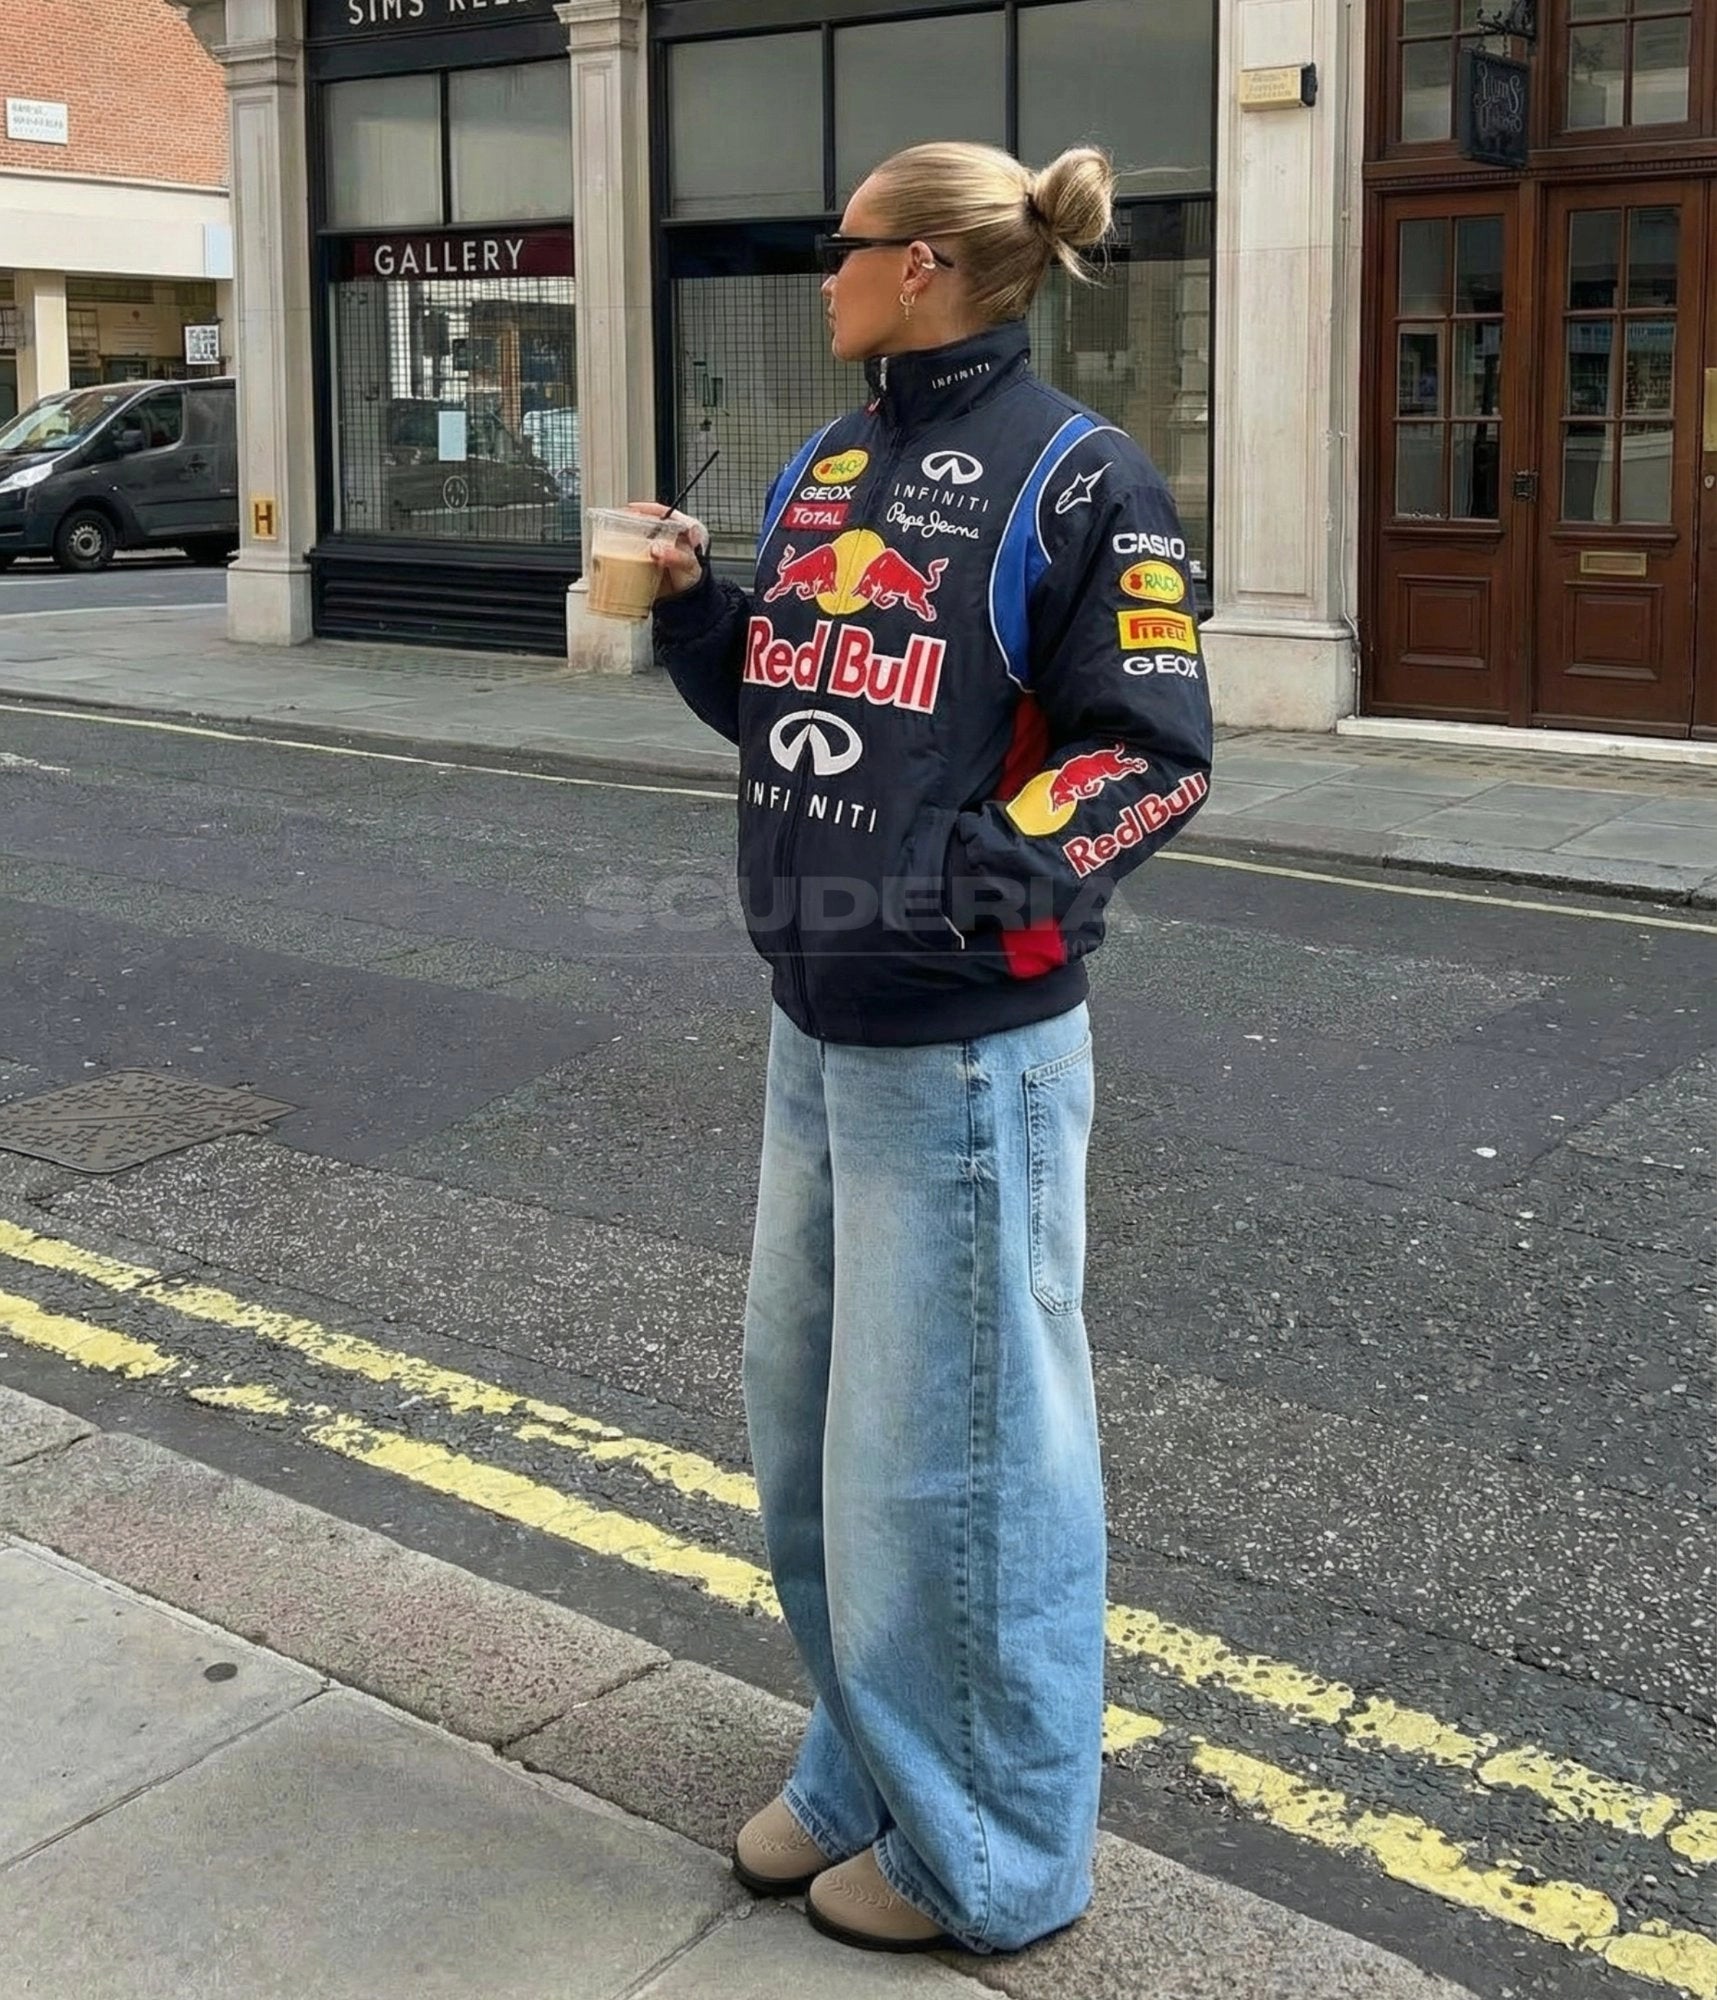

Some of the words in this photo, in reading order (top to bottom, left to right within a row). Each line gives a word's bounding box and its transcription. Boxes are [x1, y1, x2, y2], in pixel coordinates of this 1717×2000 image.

[374, 239, 524, 275] GALLERY
[931, 362, 991, 389] INFINITI
[800, 485, 857, 500] GEOX
[894, 483, 989, 512] INFINITI
[254, 503, 273, 535] H
[792, 507, 843, 525] TOTAL
[886, 501, 926, 533] Pepe
[921, 510, 980, 539] Jeans
[1112, 532, 1186, 561] CASIO
[743, 616, 834, 692] Red
[827, 623, 947, 715] Bull
[1122, 654, 1199, 679] GEOX
[1062, 806, 1143, 879] Red
[1134, 772, 1208, 834] Bull
